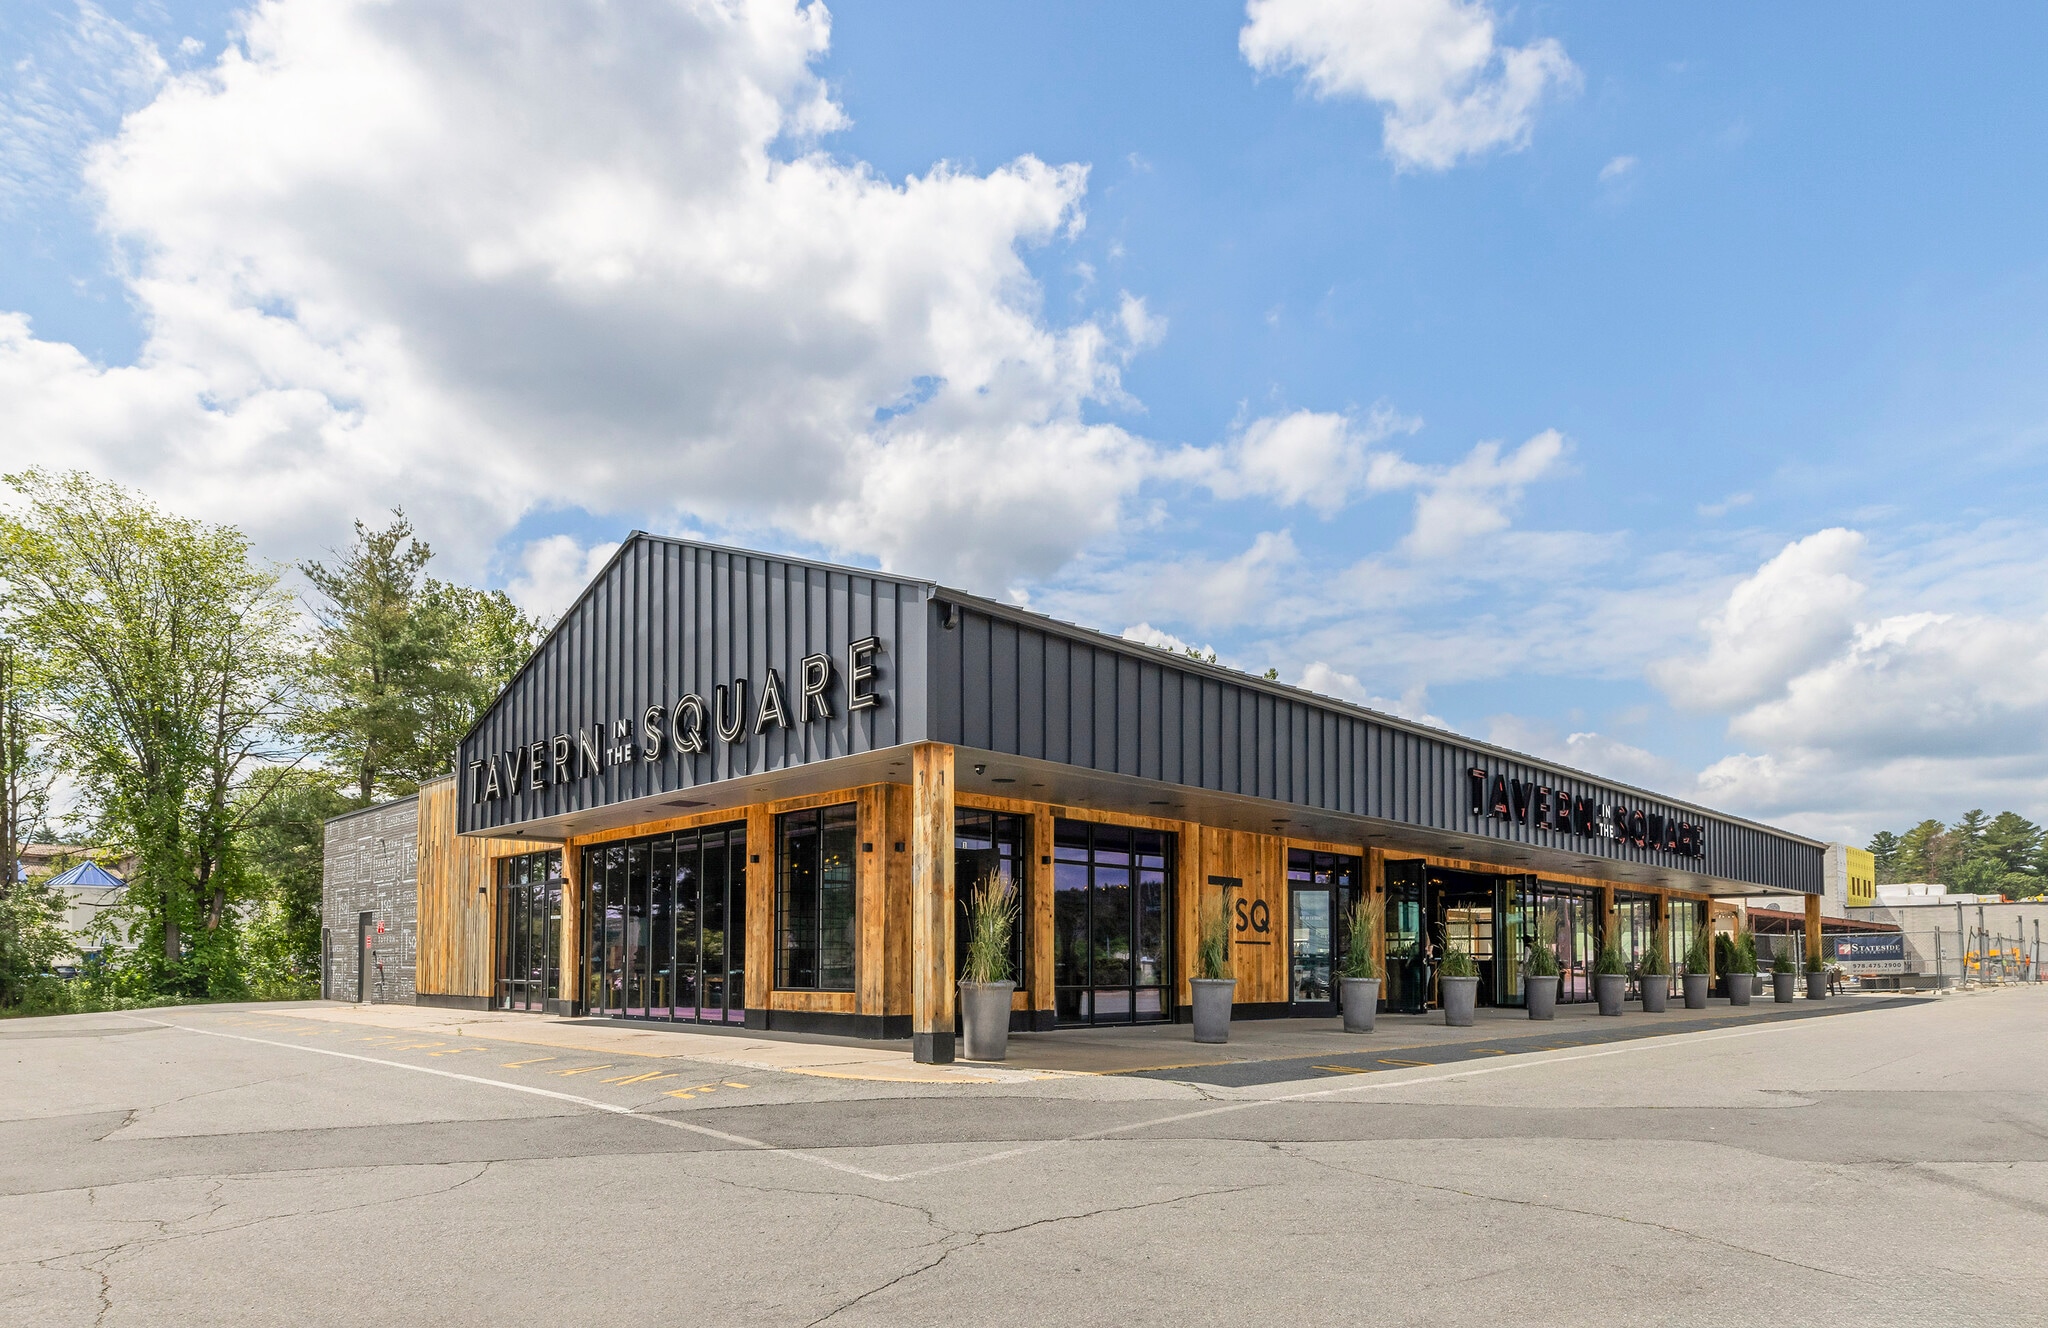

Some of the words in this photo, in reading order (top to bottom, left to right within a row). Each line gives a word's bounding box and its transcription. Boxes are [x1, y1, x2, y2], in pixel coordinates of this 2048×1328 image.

[643, 636, 880, 762] SQUARE
[612, 718, 631, 739] IN
[469, 723, 604, 804] TAVERN
[607, 743, 634, 766] THE
[1468, 767, 1594, 838] TAVERN
[1600, 804, 1611, 818] IN
[1599, 823, 1614, 838] THE
[1613, 806, 1704, 860] SQUARE
[1851, 943, 1900, 952] STATESIDE
[500, 1057, 751, 1099] LANE
